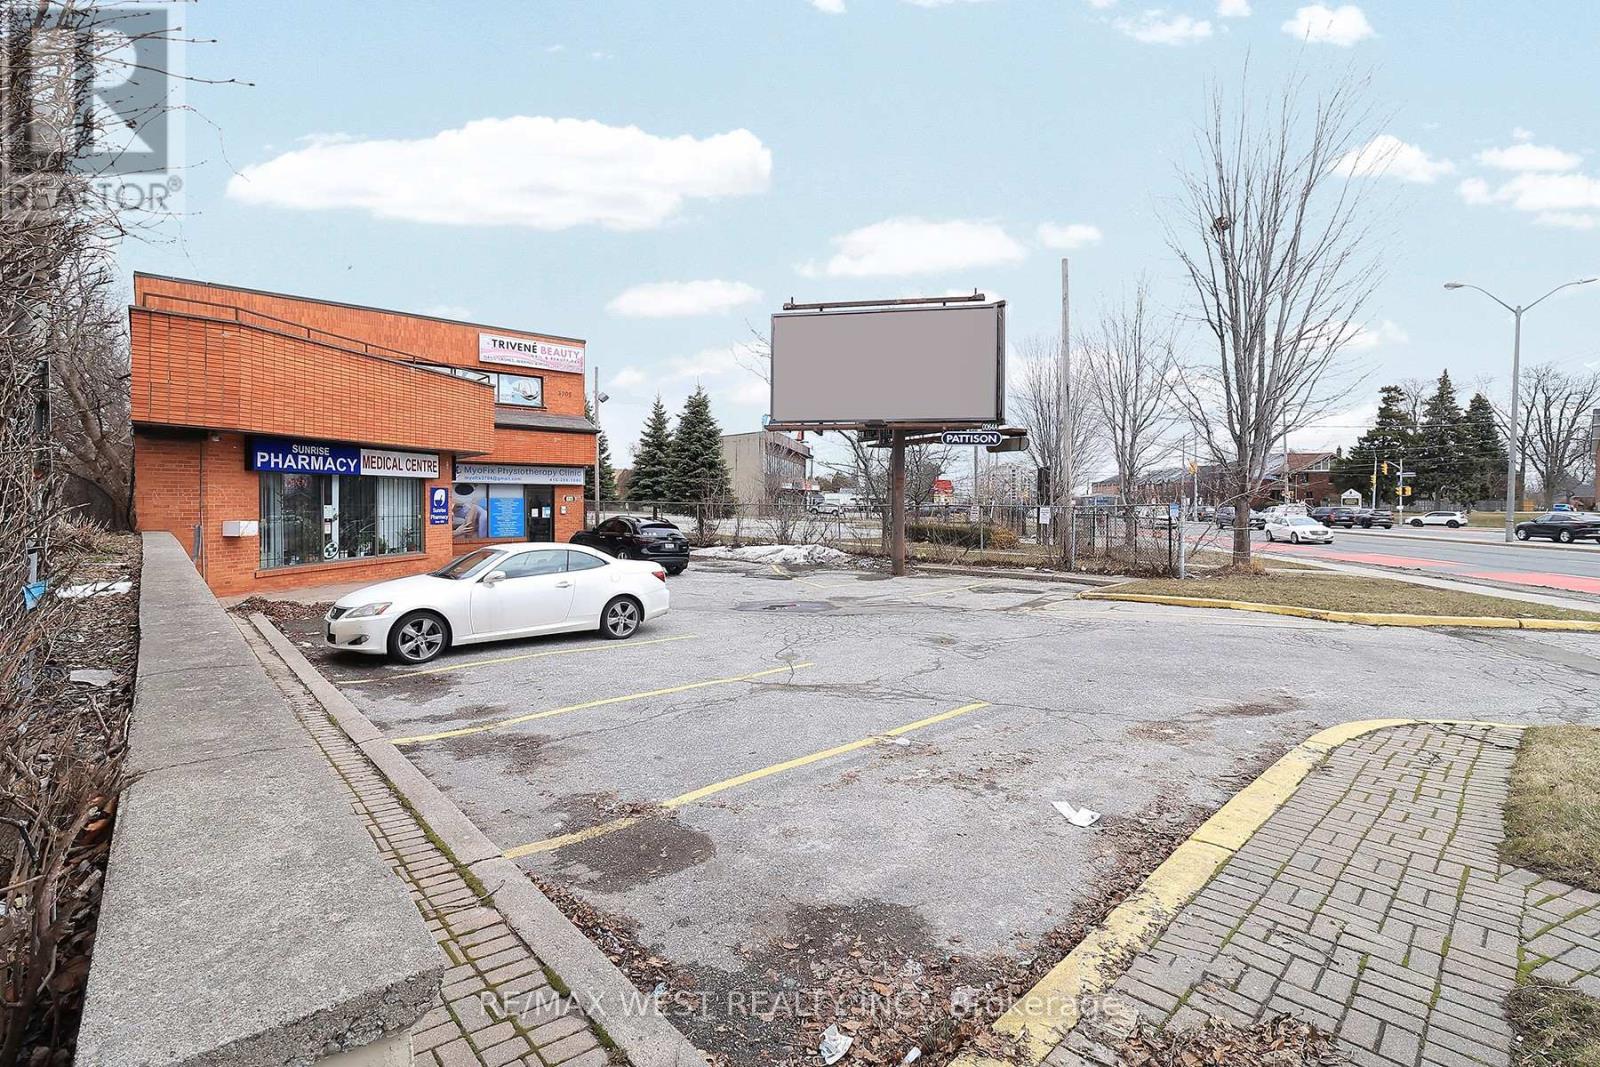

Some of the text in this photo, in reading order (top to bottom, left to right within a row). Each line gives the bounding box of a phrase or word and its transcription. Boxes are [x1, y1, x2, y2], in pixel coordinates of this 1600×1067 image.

[491, 338, 580, 359] TRIVENÉ BEAUTY
[946, 434, 997, 443] PATTISON
[292, 444, 330, 456] SUNRISE
[256, 451, 359, 472] PHARMACY
[362, 454, 438, 473] MEDICAL CENTRE
[464, 465, 581, 478] MyoFix Physiotherapy Clinic
